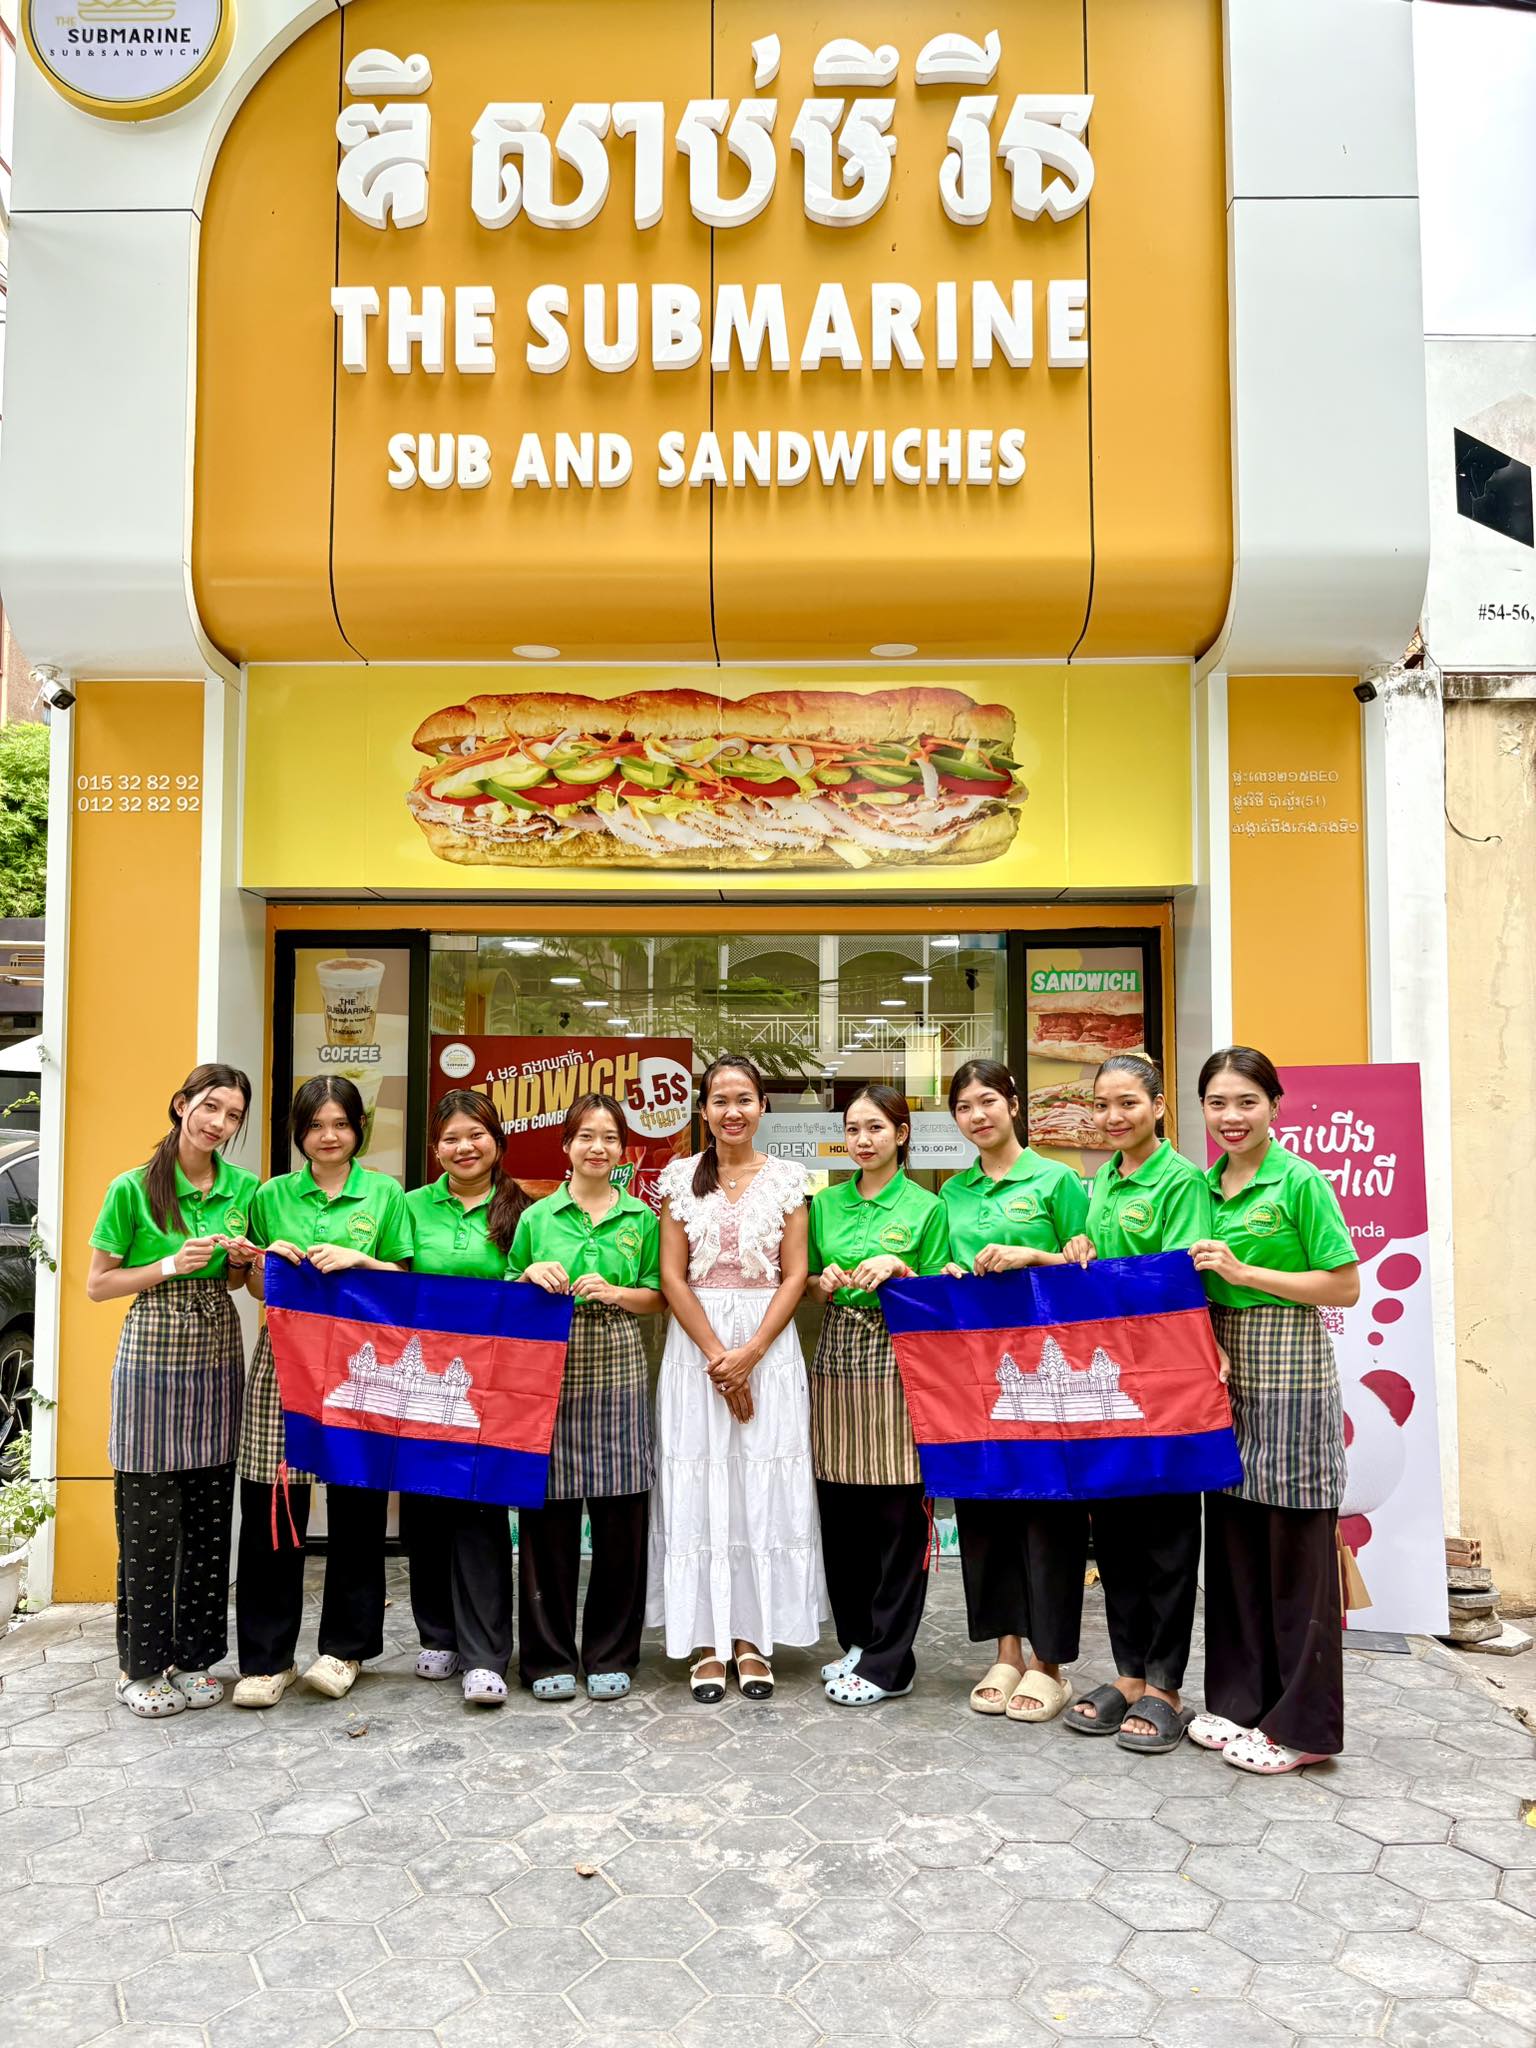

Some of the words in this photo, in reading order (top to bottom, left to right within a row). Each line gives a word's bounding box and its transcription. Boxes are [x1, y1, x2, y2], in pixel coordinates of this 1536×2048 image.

[55, 16, 77, 27] THE
[68, 27, 192, 44] SUBMARINE
[331, 285, 496, 375] THE
[526, 279, 1089, 373] SUBMARINE
[387, 433, 492, 490] SUB
[511, 433, 633, 489] AND
[658, 428, 1027, 489] SANDWICHES
[1478, 603, 1535, 622] #54-56,
[77, 775, 113, 790] 015
[118, 775, 141, 790] 32
[147, 775, 170, 790] 82
[175, 775, 199, 790] 92
[77, 796, 113, 812] 012
[118, 796, 142, 812] 32
[147, 796, 171, 812] 82
[176, 796, 200, 812] 92
[1033, 972, 1137, 992] SANDWICH
[326, 1005, 371, 1015] SUBMARINE
[339, 998, 357, 1006] THE
[320, 1045, 380, 1062] COFFEE
[486, 1070, 494, 1082] 4
[587, 1050, 594, 1061] 1
[468, 1052, 639, 1122] NDWICH
[501, 1117, 529, 1135] UPER
[767, 1142, 816, 1157] OPEN
